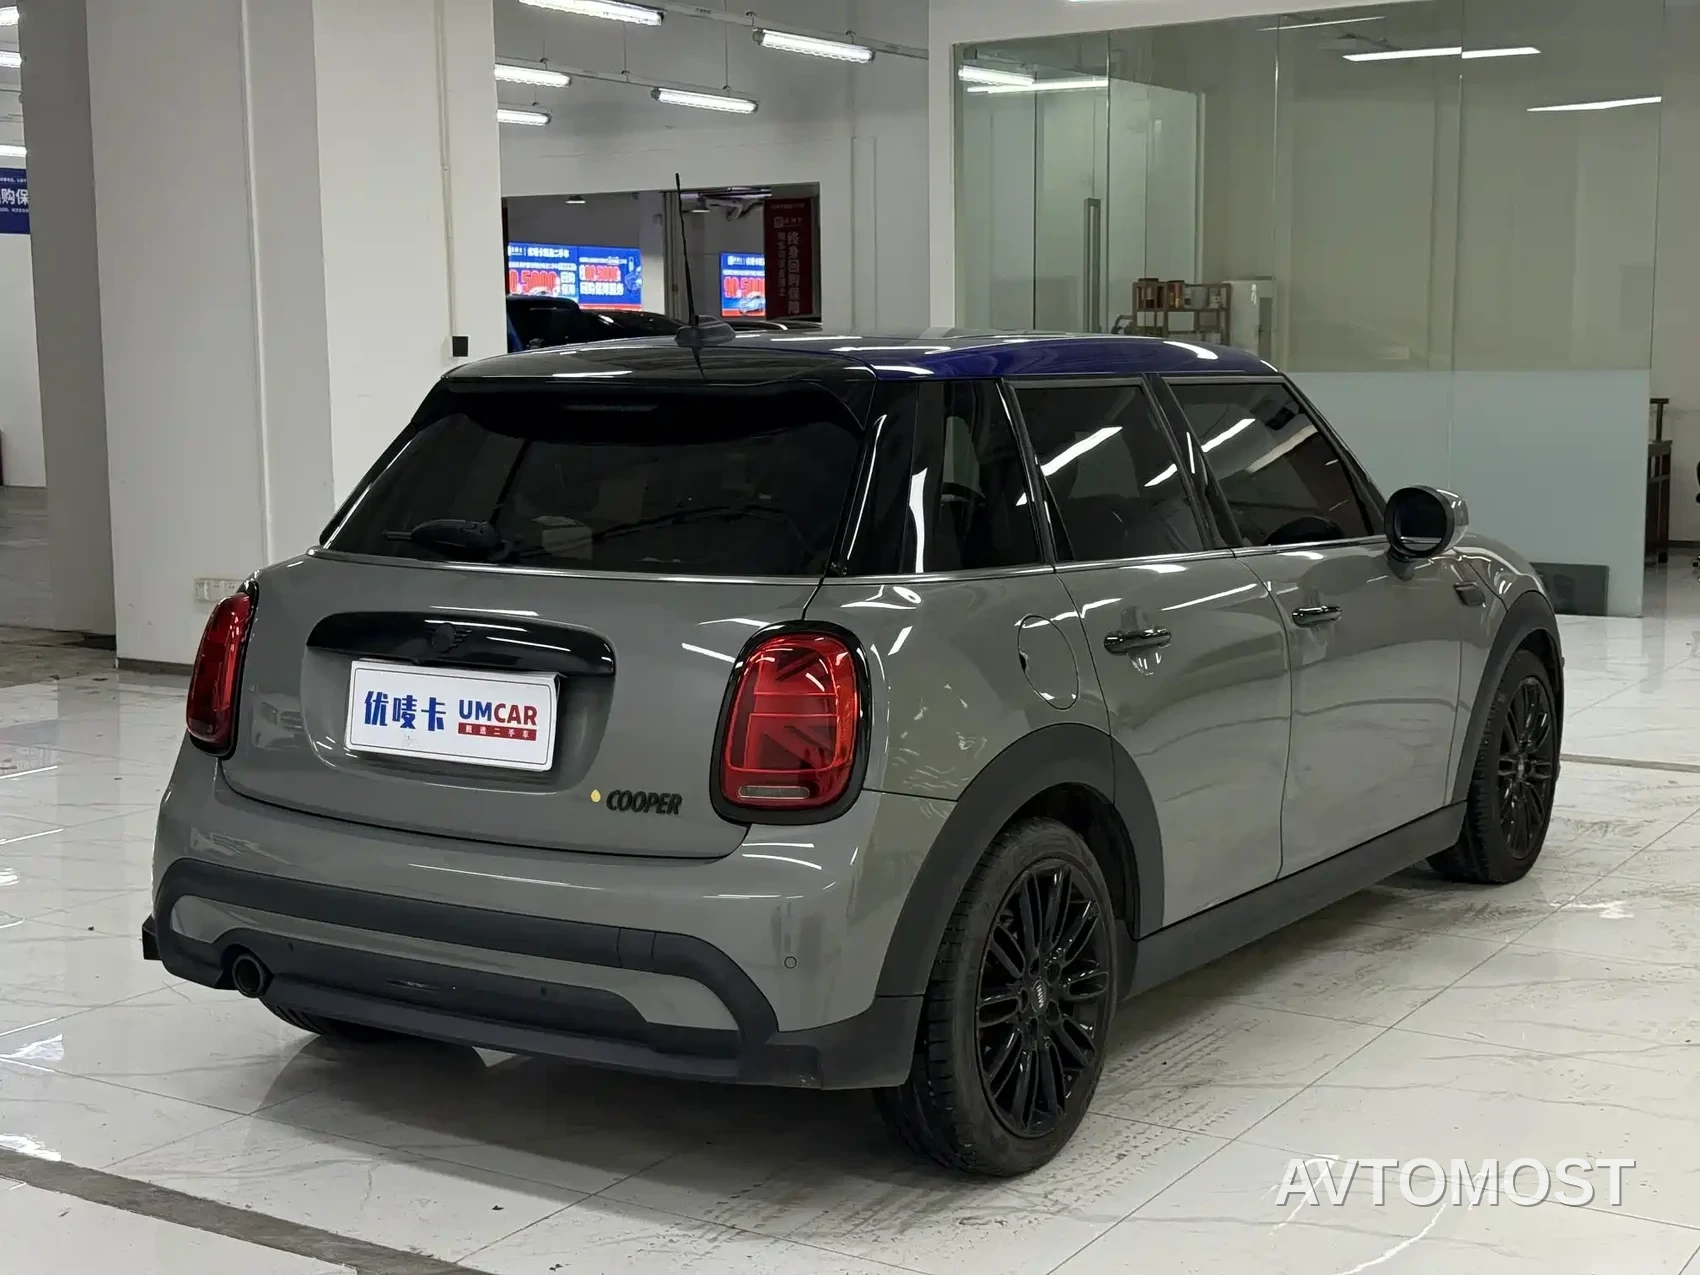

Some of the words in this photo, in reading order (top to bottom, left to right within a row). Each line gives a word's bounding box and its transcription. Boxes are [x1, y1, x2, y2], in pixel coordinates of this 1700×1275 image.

[0, 188, 28, 205] 购保
[364, 690, 447, 731] 优唛卡
[458, 699, 538, 726] UMCAR
[606, 789, 683, 815] COOPER
